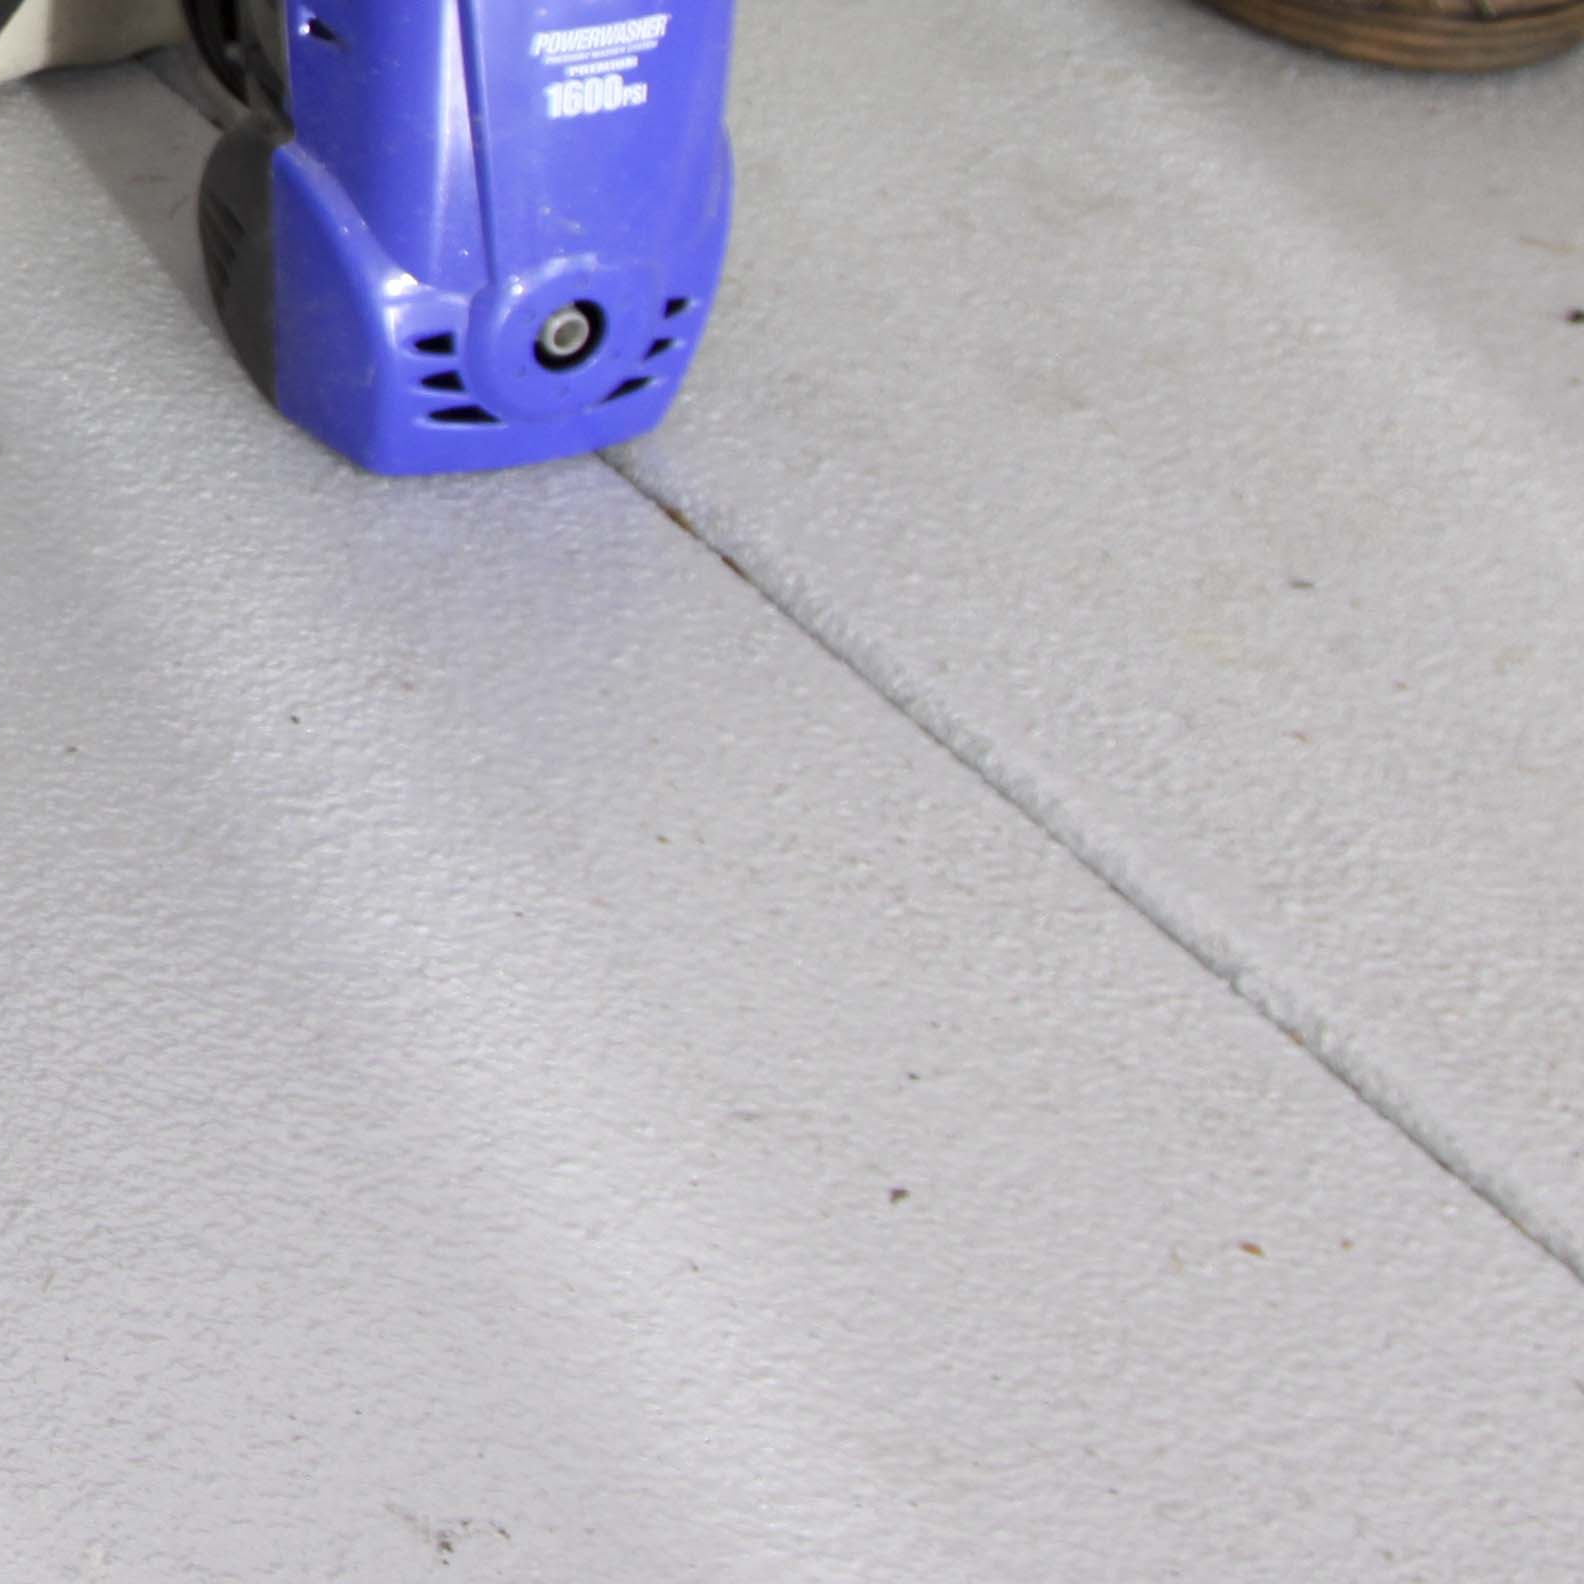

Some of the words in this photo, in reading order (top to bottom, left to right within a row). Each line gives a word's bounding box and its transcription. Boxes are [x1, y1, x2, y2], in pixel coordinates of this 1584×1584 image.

[531, 13, 668, 56] POWERWASHER
[543, 73, 623, 119] 1600
[623, 83, 648, 106] PSI
